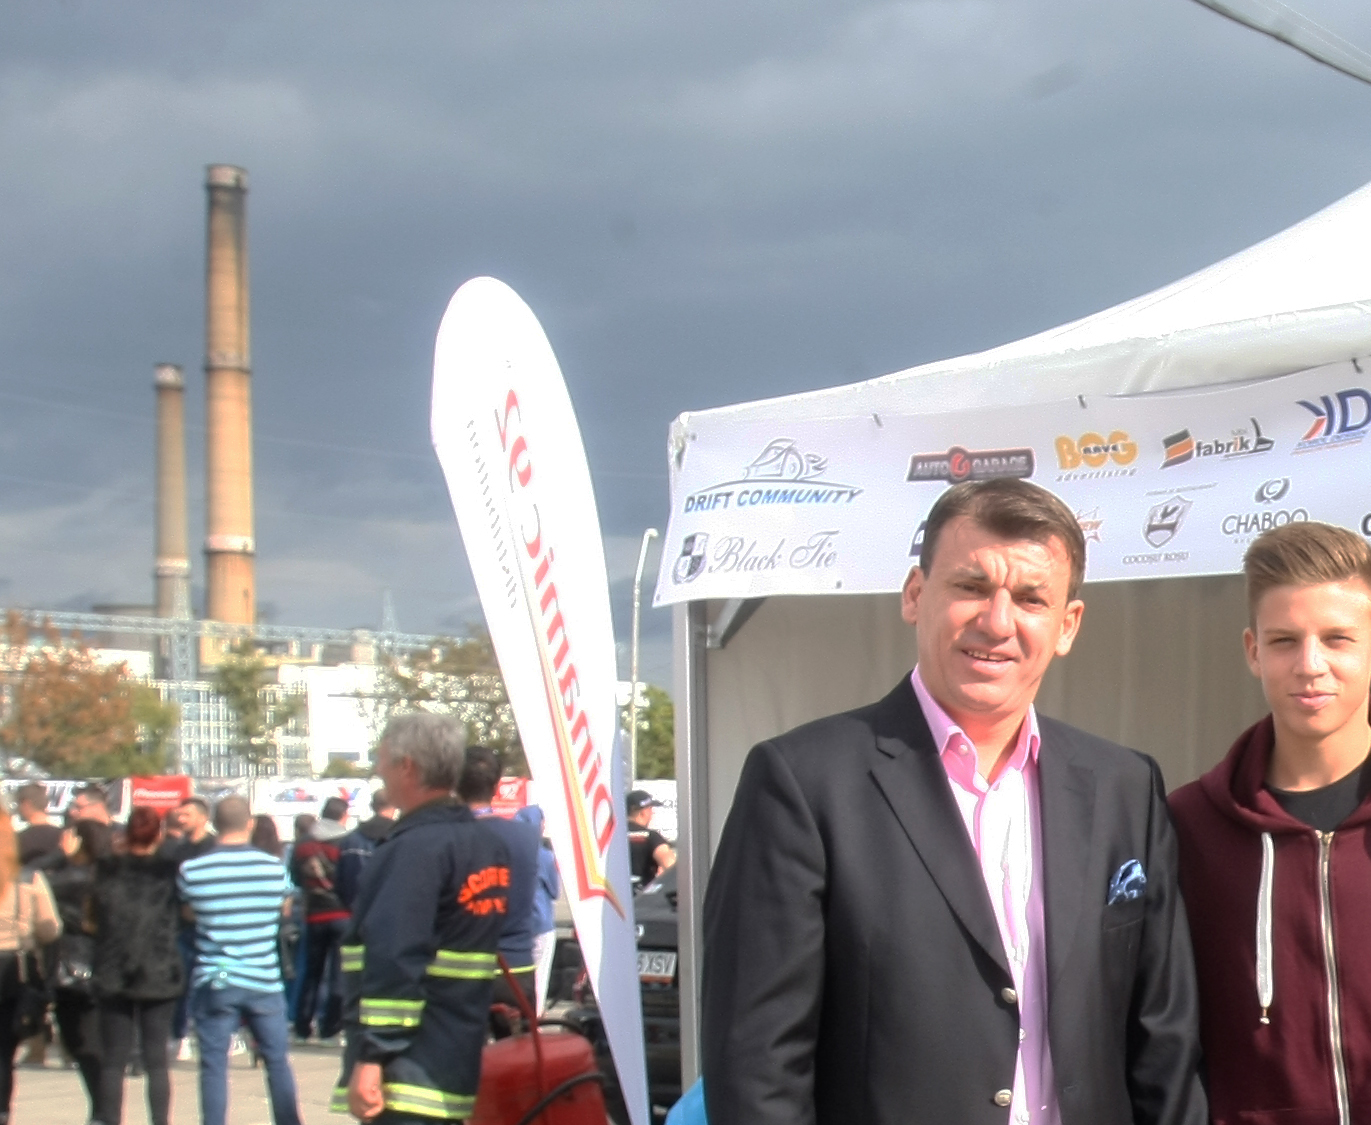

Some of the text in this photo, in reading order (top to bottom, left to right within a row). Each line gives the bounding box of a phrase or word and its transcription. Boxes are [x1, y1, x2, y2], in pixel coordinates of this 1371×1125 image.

[1195, 435, 1250, 457] fabrik
[685, 489, 864, 513] DRIFT COMMUNITY
[708, 530, 840, 573] Black Tie
